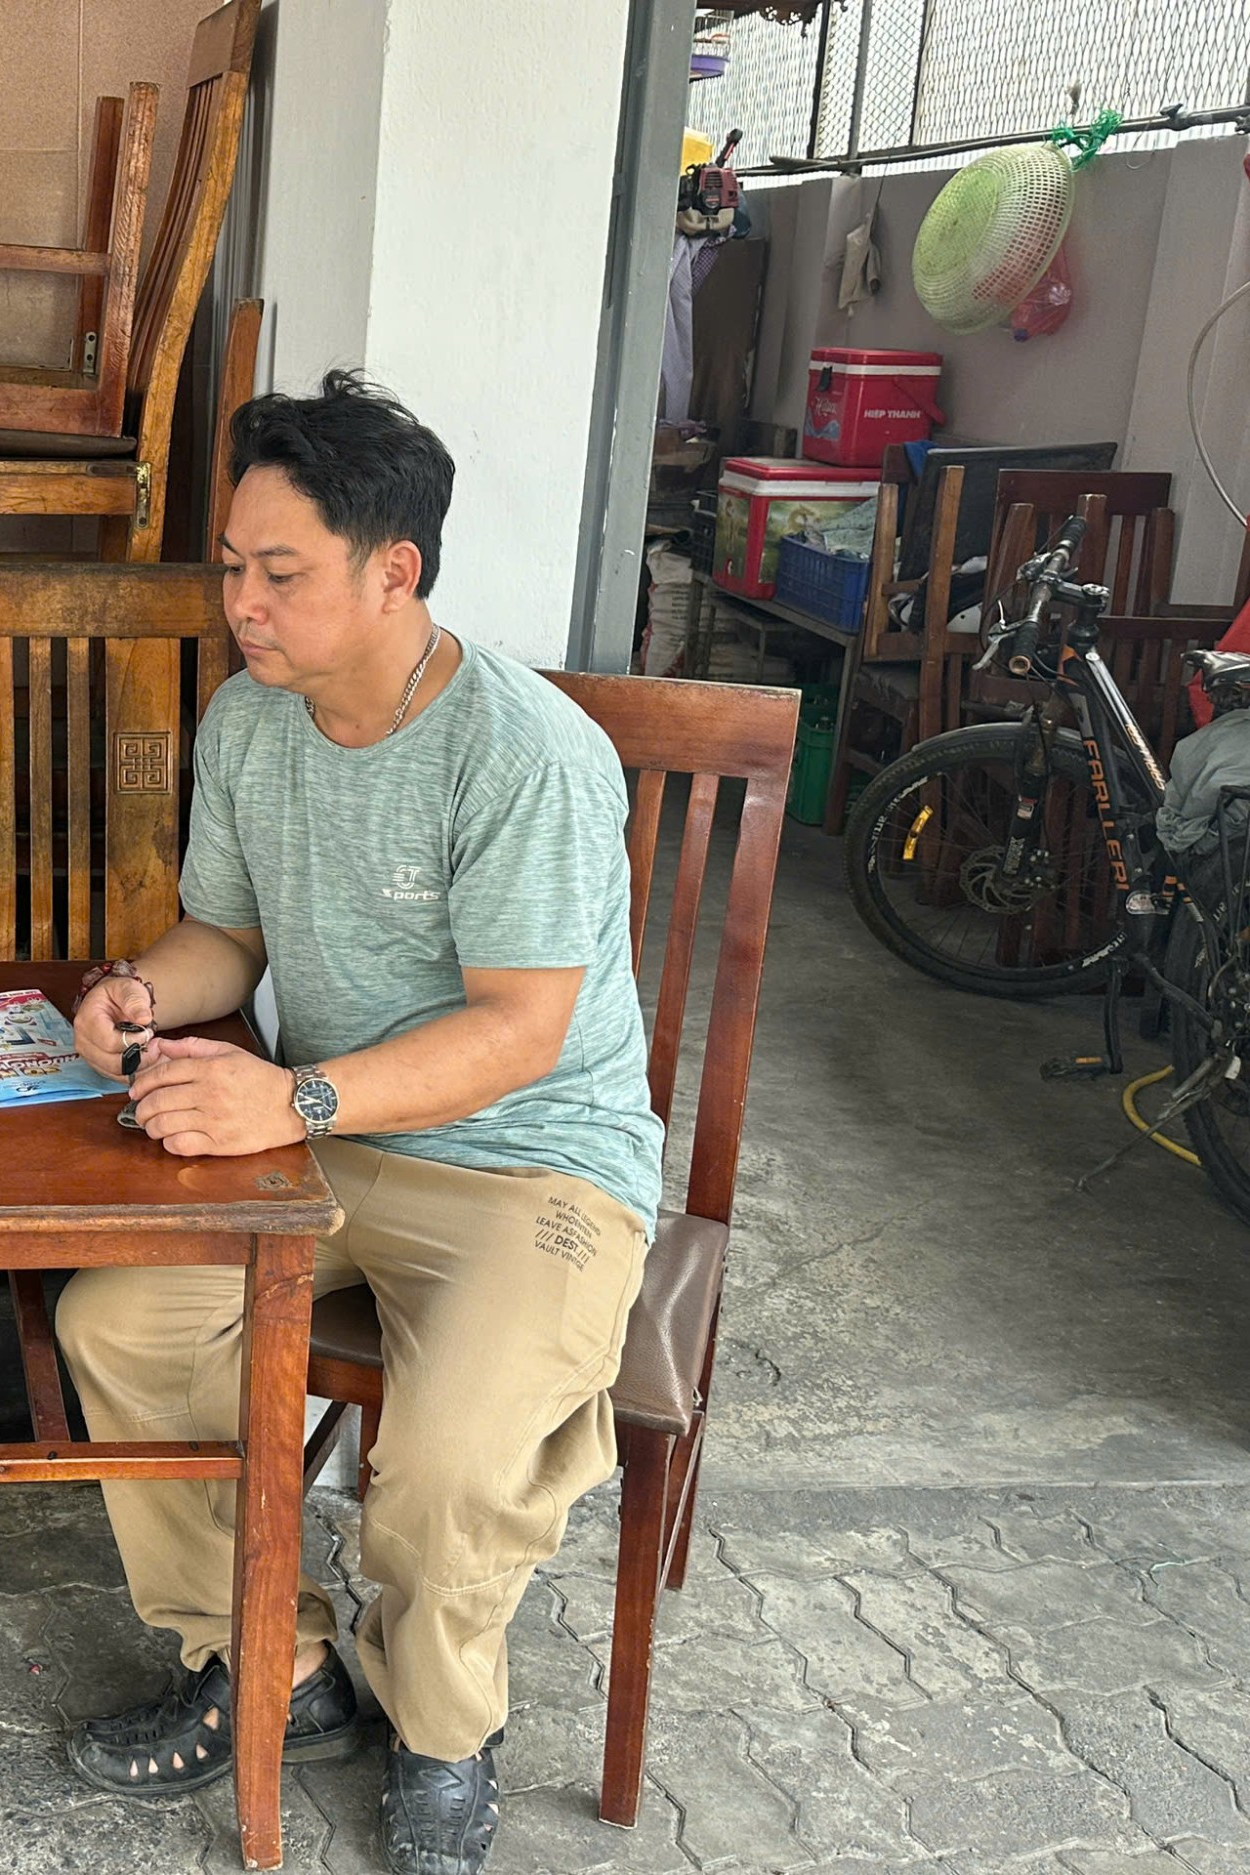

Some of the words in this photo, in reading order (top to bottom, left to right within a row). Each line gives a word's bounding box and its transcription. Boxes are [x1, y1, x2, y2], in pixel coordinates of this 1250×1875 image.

[548, 1196, 569, 1208] MAY
[568, 1204, 581, 1216] ALL
[536, 1216, 561, 1231] LEAVE
[535, 1240, 560, 1255] VAULT
